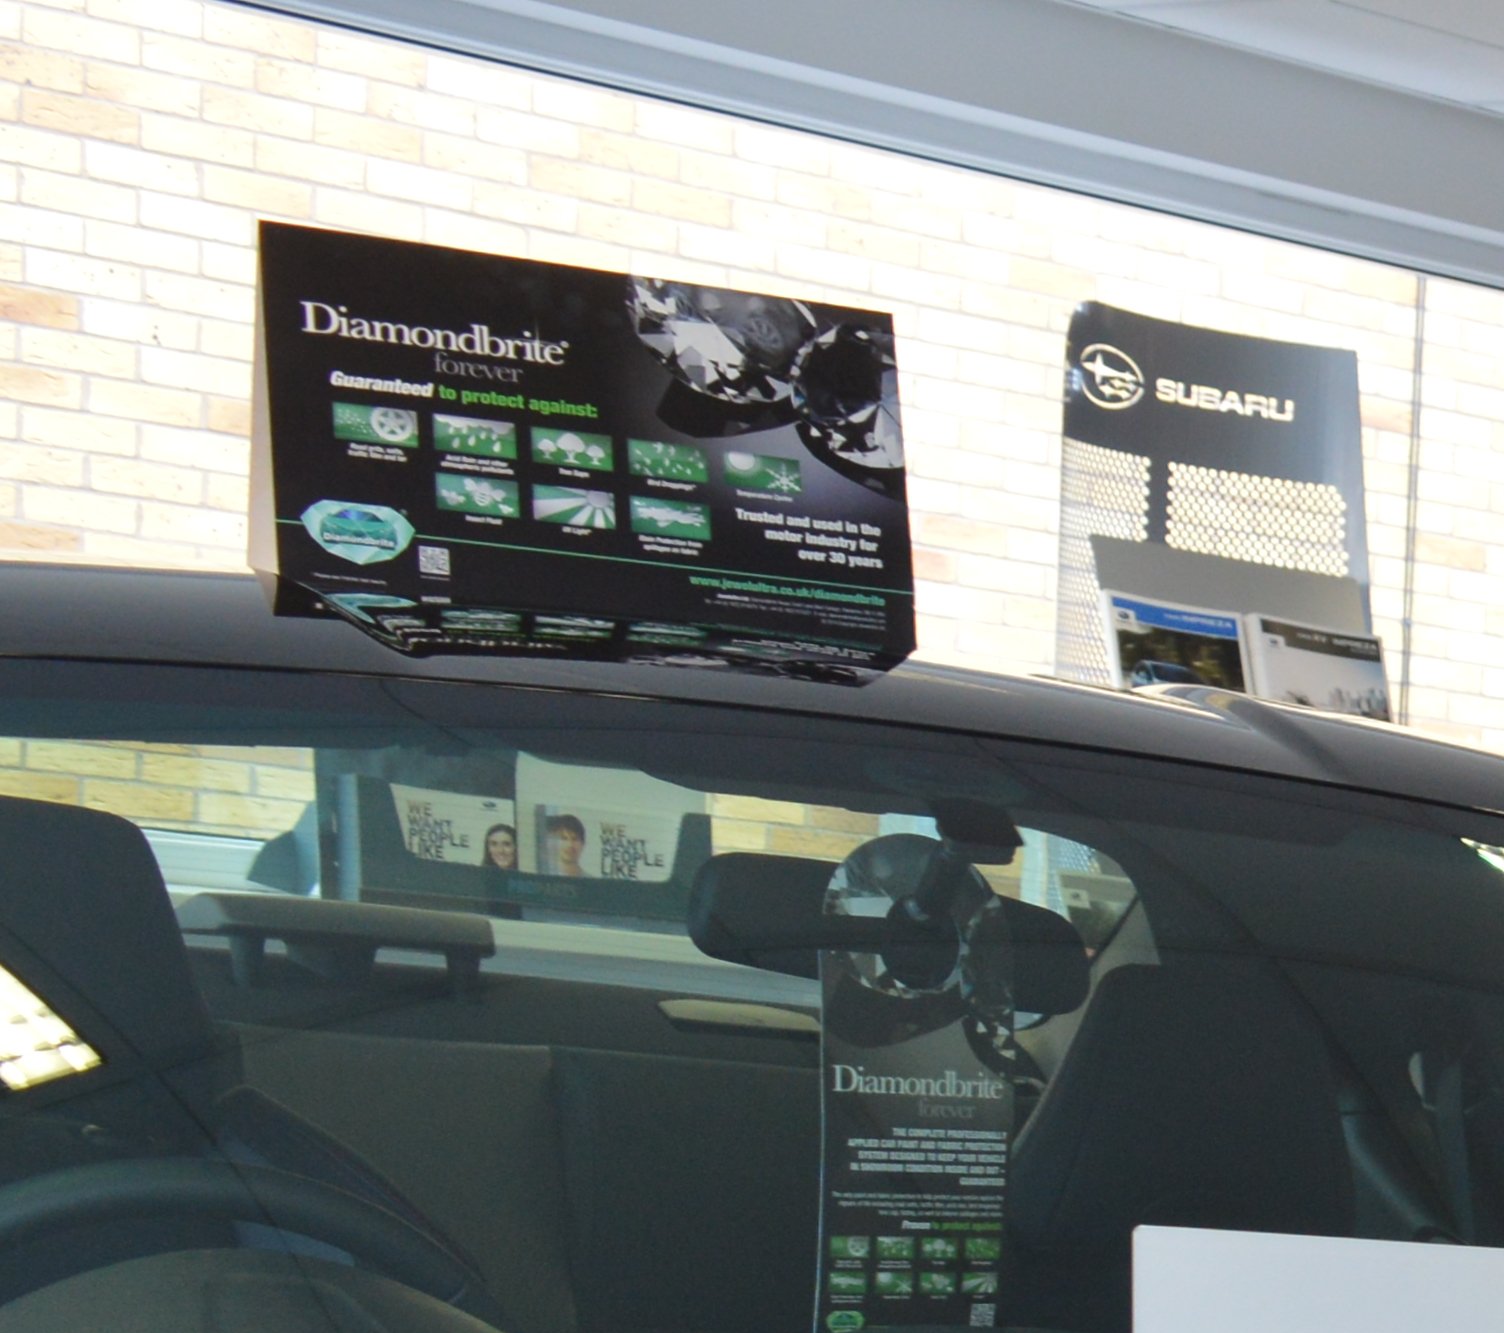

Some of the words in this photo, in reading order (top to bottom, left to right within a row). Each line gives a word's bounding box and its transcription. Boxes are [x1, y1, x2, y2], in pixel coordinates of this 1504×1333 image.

[434, 352, 523, 383] forever
[330, 370, 434, 398] Guaranteed
[438, 384, 457, 400] to
[461, 388, 524, 411] protect
[529, 397, 598, 418] against:
[1155, 377, 1294, 422] SUBARU
[735, 507, 783, 525] Trusted
[787, 511, 810, 528] and
[813, 515, 843, 532] used
[846, 519, 859, 534] in
[861, 521, 881, 537] the
[764, 530, 803, 544] motor
[805, 532, 857, 551] industry
[860, 539, 878, 553] for
[798, 549, 826, 563] over
[848, 556, 883, 569] years
[408, 801, 432, 817] WE
[408, 814, 453, 834] WANT
[601, 822, 626, 838] WE
[409, 827, 471, 849] PEOPLE
[602, 834, 646, 854] WANT
[409, 842, 445, 860] LIKE
[602, 848, 664, 867] PEOPLE
[602, 862, 638, 878] LIKE
[832, 1064, 1003, 1099] Diamondbrite
